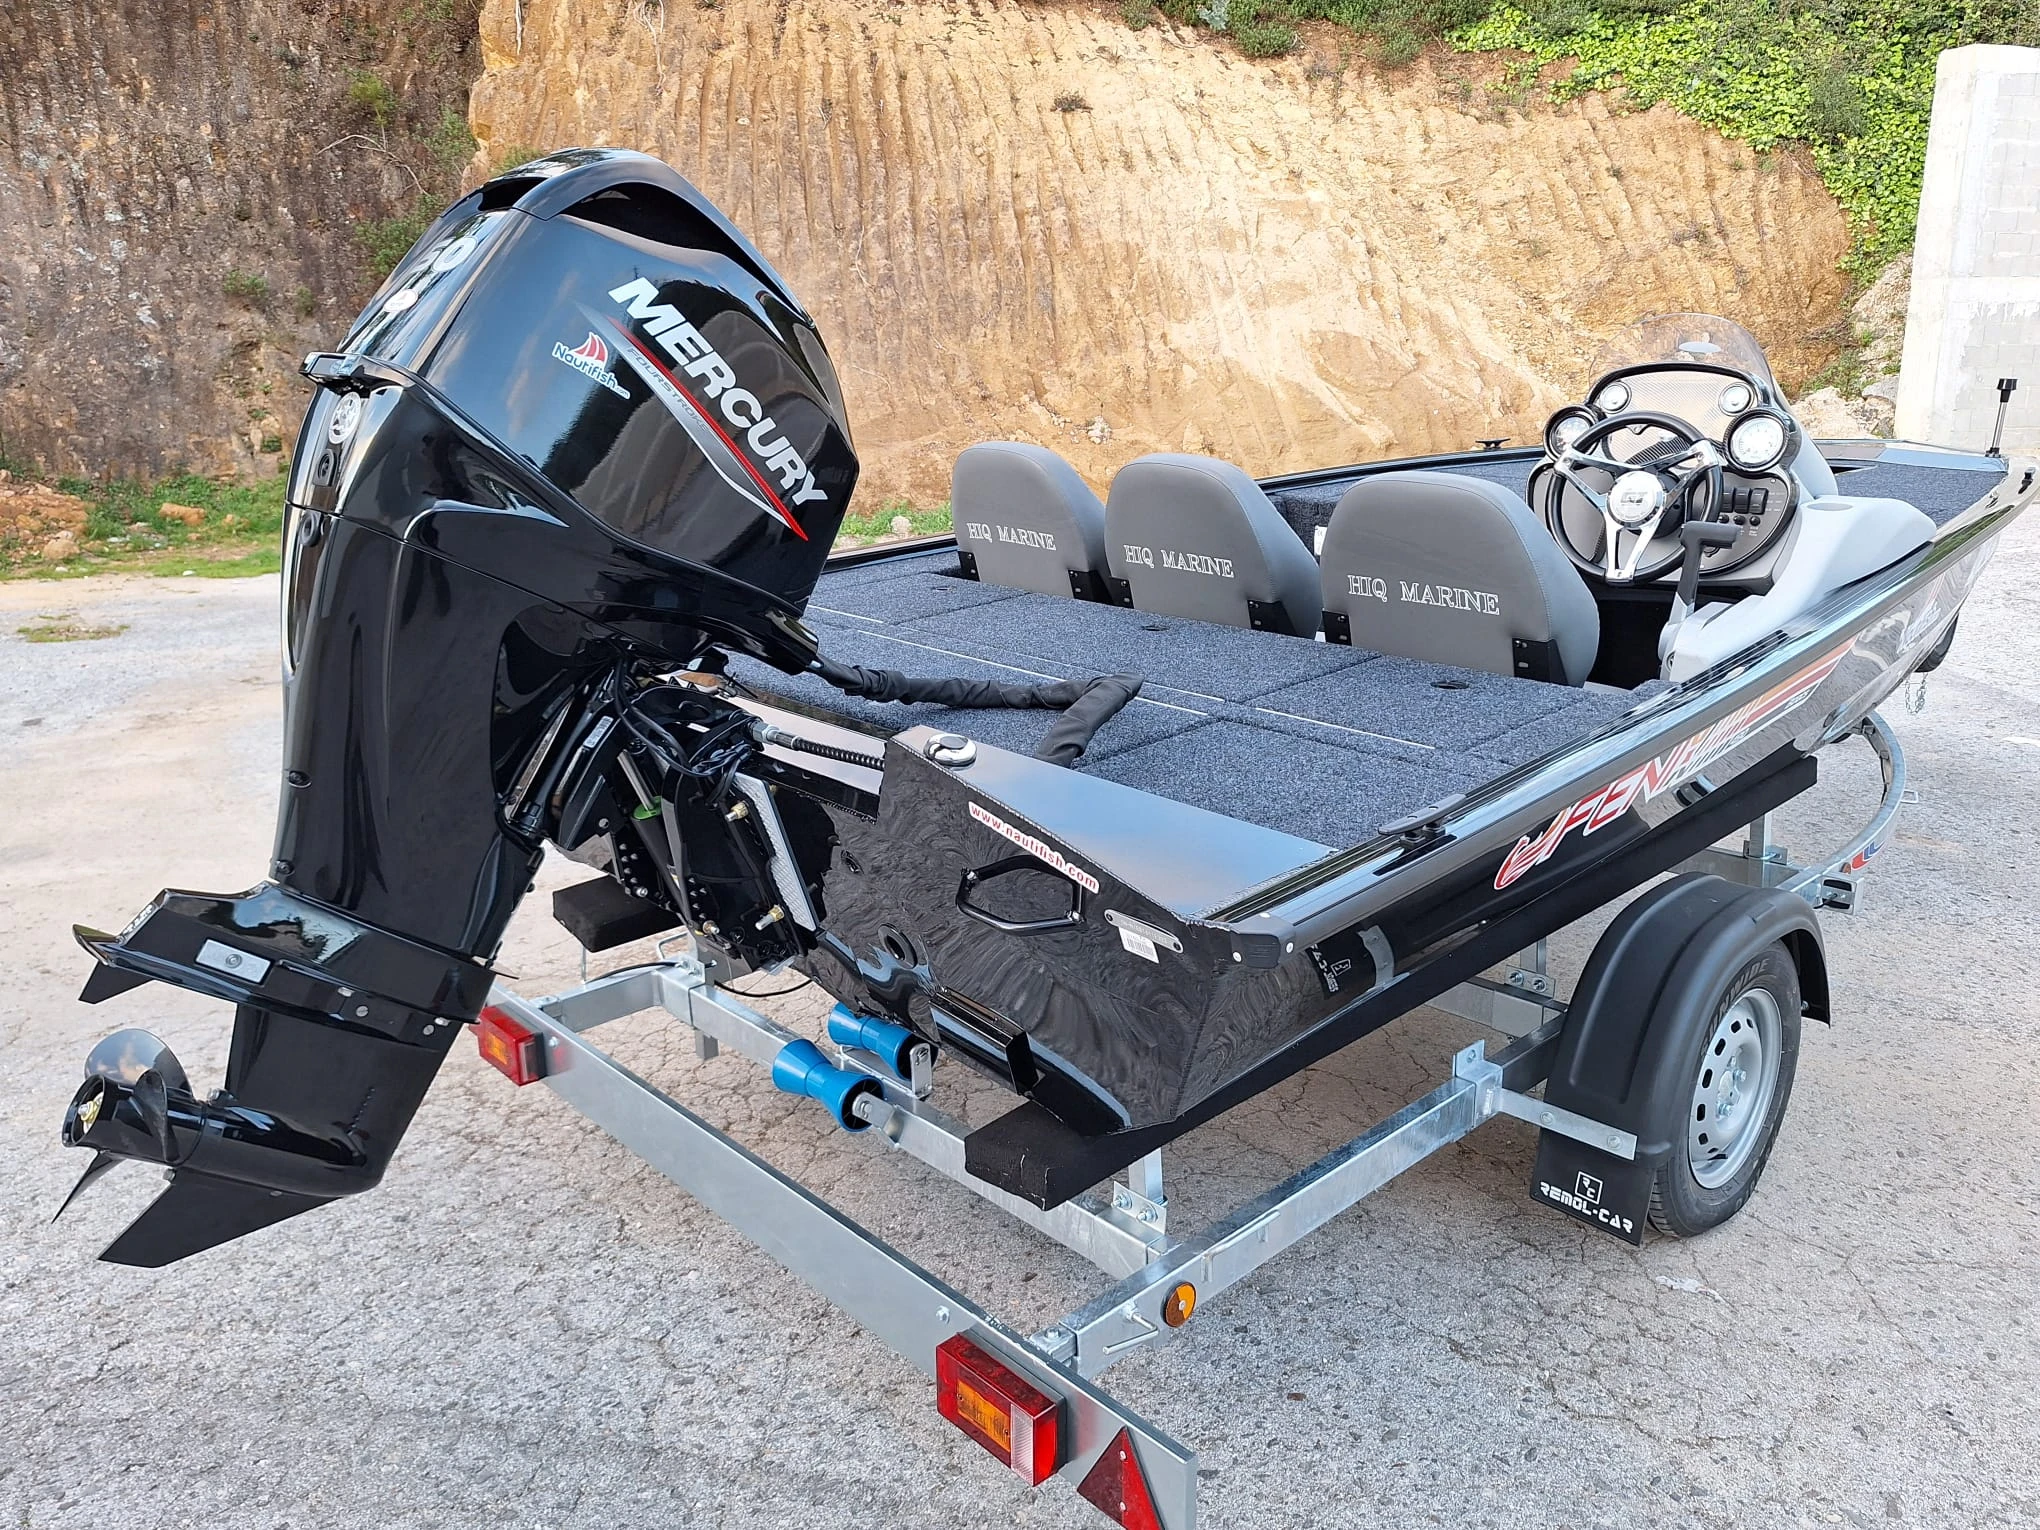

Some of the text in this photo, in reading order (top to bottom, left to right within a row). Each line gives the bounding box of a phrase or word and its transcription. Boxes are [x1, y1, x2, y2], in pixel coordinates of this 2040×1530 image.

[608, 277, 828, 505] MERCURY
[627, 347, 710, 432] FOURSTROKE
[967, 522, 1057, 551] HIQ MARINE
[1123, 544, 1234, 579] HIQ MARINE
[1347, 574, 1500, 616] HIQ MARINE
[971, 805, 1097, 890] www.nautifish.com
[1540, 1181, 1633, 1234] REMOL-CAR
